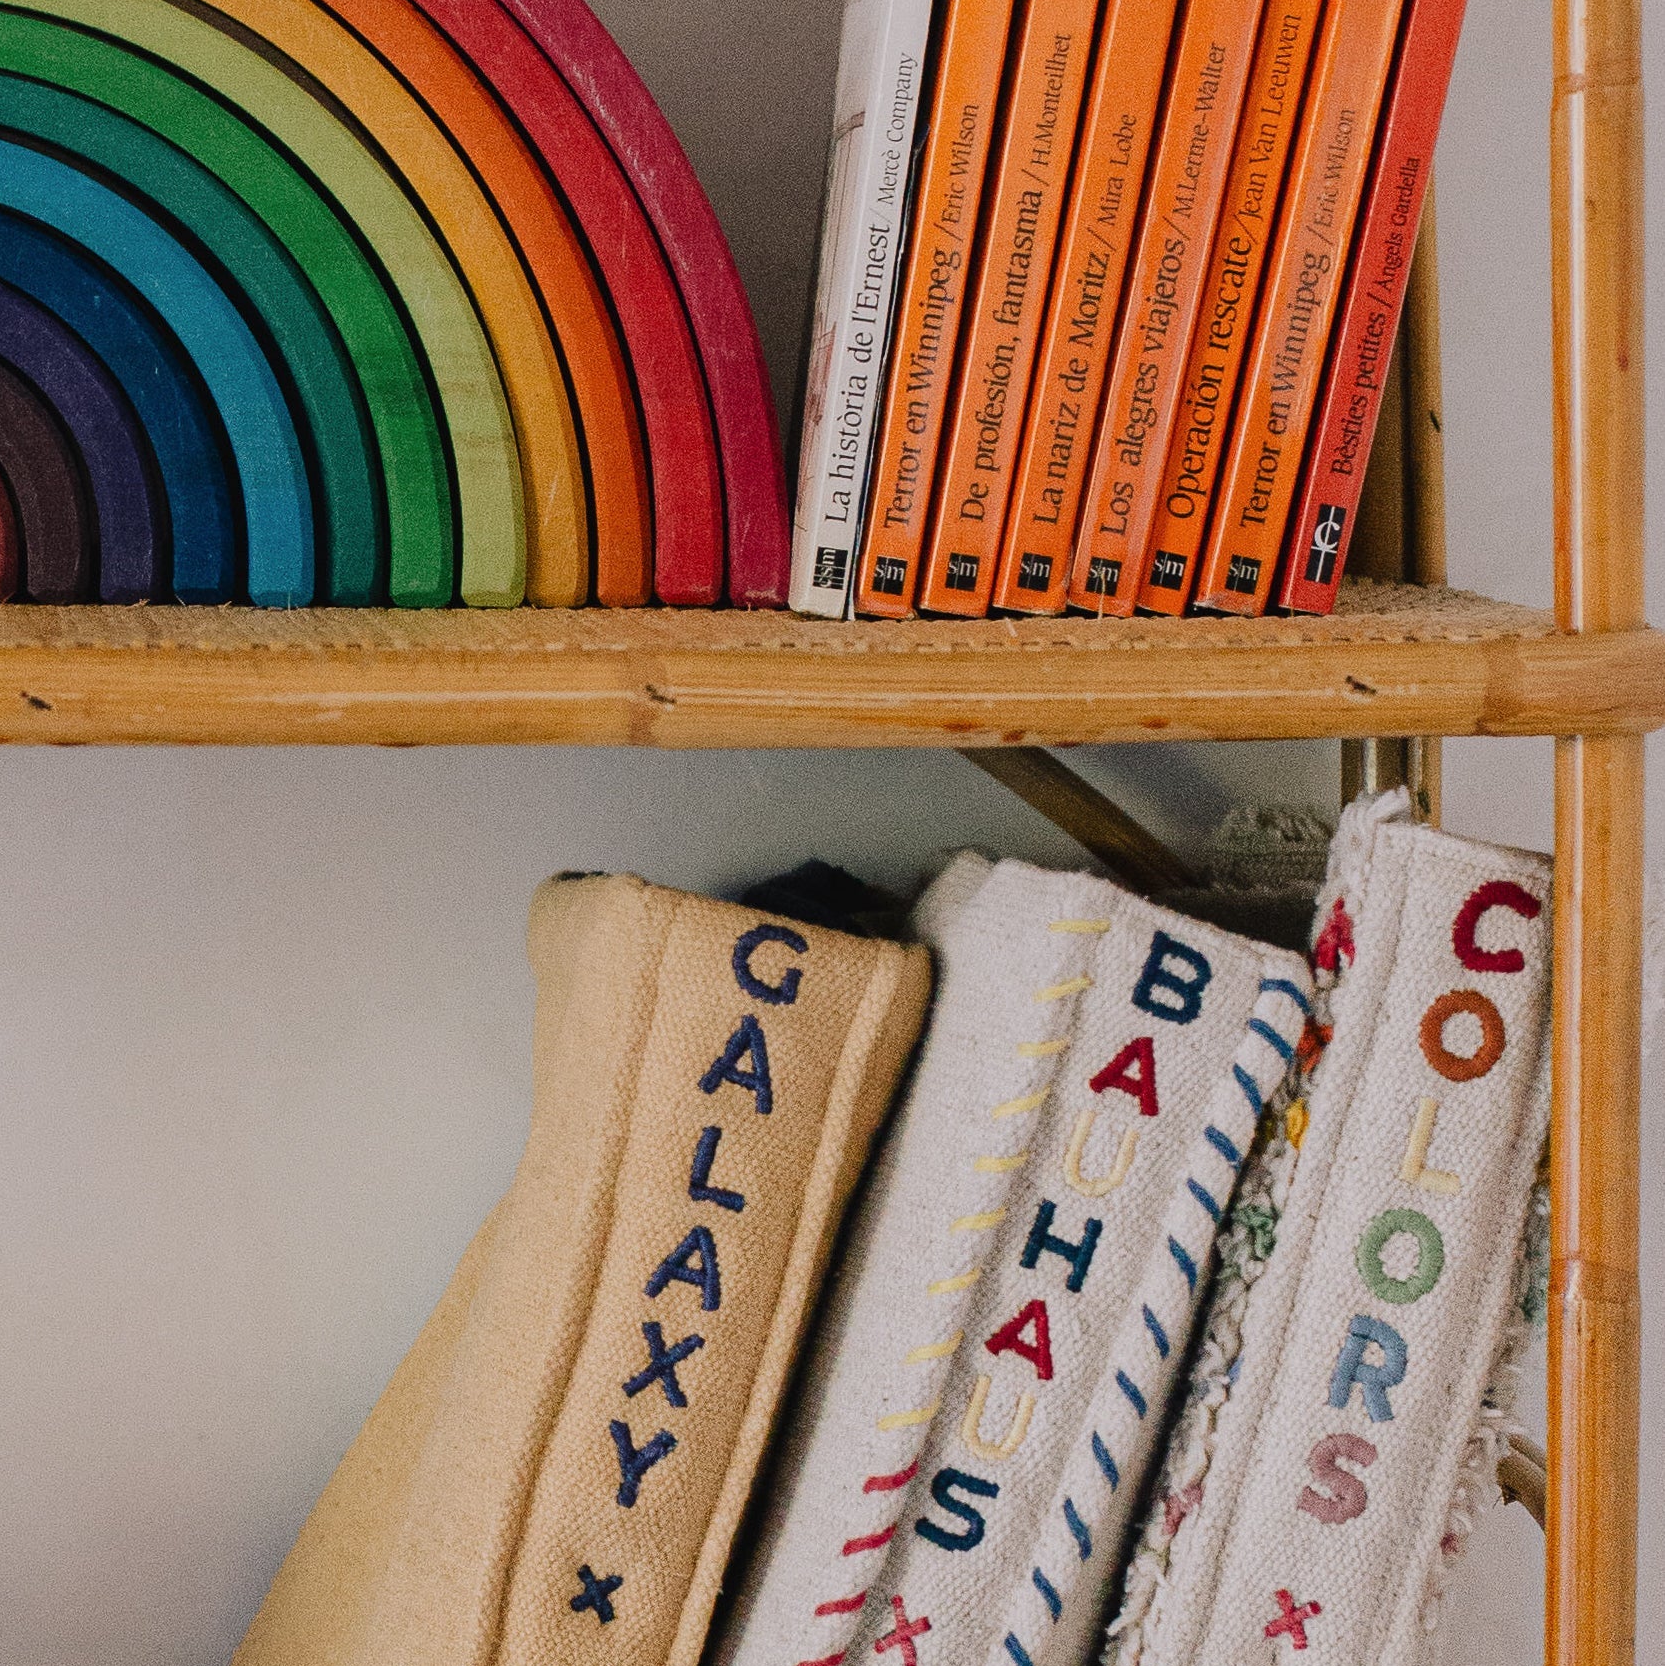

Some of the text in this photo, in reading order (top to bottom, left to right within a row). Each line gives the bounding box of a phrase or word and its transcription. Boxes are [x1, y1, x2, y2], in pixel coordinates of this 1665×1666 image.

[887, 53, 917, 142] Company
[1260, 14, 1302, 116] Leeuwen
[877, 150, 900, 205] Mercè
[949, 104, 979, 176] Wilson
[1110, 115, 1136, 165] Lobe
[1249, 123, 1278, 163] Van
[1324, 109, 1354, 179] Wilson
[1097, 177, 1124, 226] Mira
[1238, 172, 1267, 222] Jean
[906, 248, 960, 392] Winnipeg
[1068, 251, 1110, 347] Moritz
[1139, 237, 1186, 353] viajeros
[1206, 237, 1252, 353] rescate
[1270, 251, 1331, 393] Winnipeg
[1329, 395, 1368, 476] Bèsties
[1353, 311, 1387, 390] petites
[1391, 157, 1420, 226] Gardella
[847, 332, 873, 363] de
[1059, 359, 1089, 392] de
[828, 375, 868, 480] història
[905, 402, 930, 434] en
[1047, 402, 1080, 480] nariz
[1115, 363, 1158, 466] alegres
[1166, 365, 1224, 518] Operación
[1266, 402, 1290, 435] en
[825, 491, 851, 523] La
[883, 441, 921, 528] Terror
[958, 483, 989, 523] De
[1033, 488, 1064, 524] La
[1099, 482, 1134, 536] Los
[1240, 441, 1281, 527] Terror
[609, 924, 809, 1508] GALAXY
[914, 930, 1213, 1552] BAUHAUS
[1296, 879, 1542, 1525] COLORS
